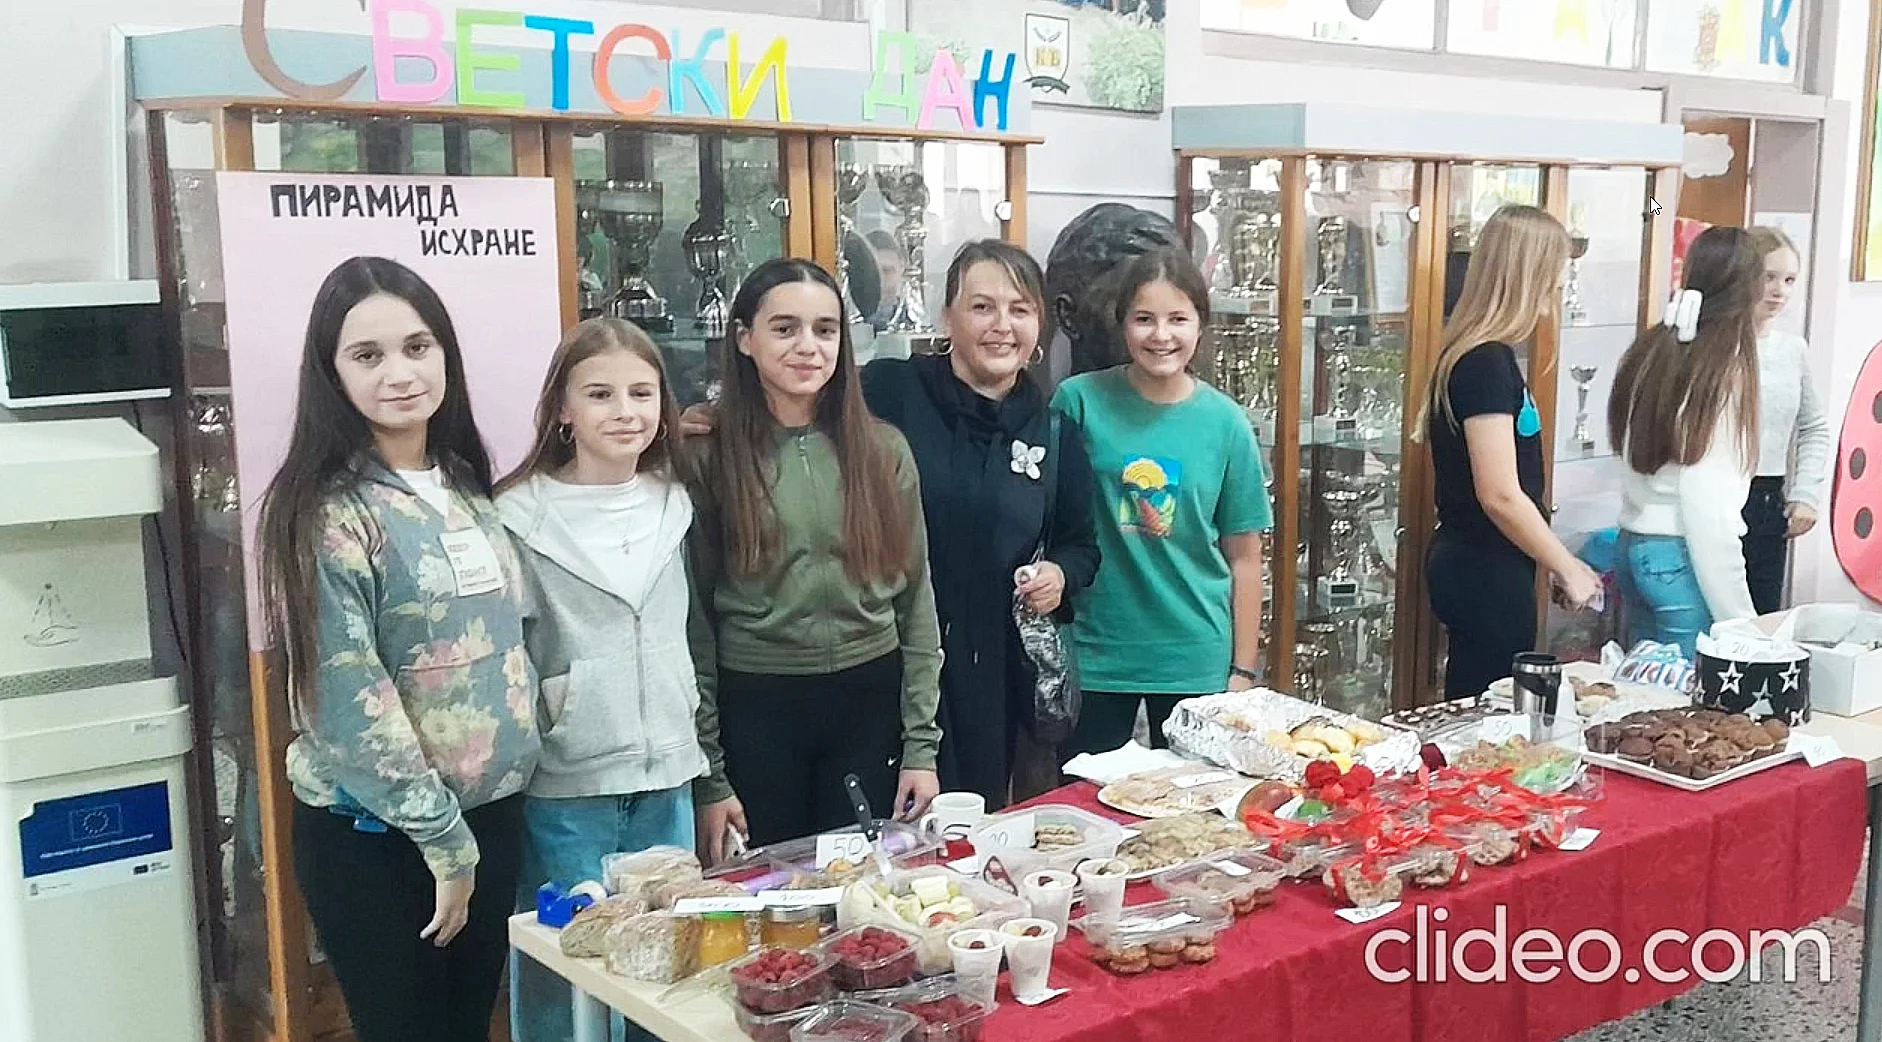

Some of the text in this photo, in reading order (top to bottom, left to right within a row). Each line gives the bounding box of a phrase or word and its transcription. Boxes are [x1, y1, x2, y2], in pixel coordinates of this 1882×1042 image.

[241, 0, 1016, 130] СВЕТСКИ ДАН
[270, 184, 459, 226] ПИРАМИДА
[420, 228, 537, 257] ИСХРАНЕ
[833, 836, 865, 857] 50
